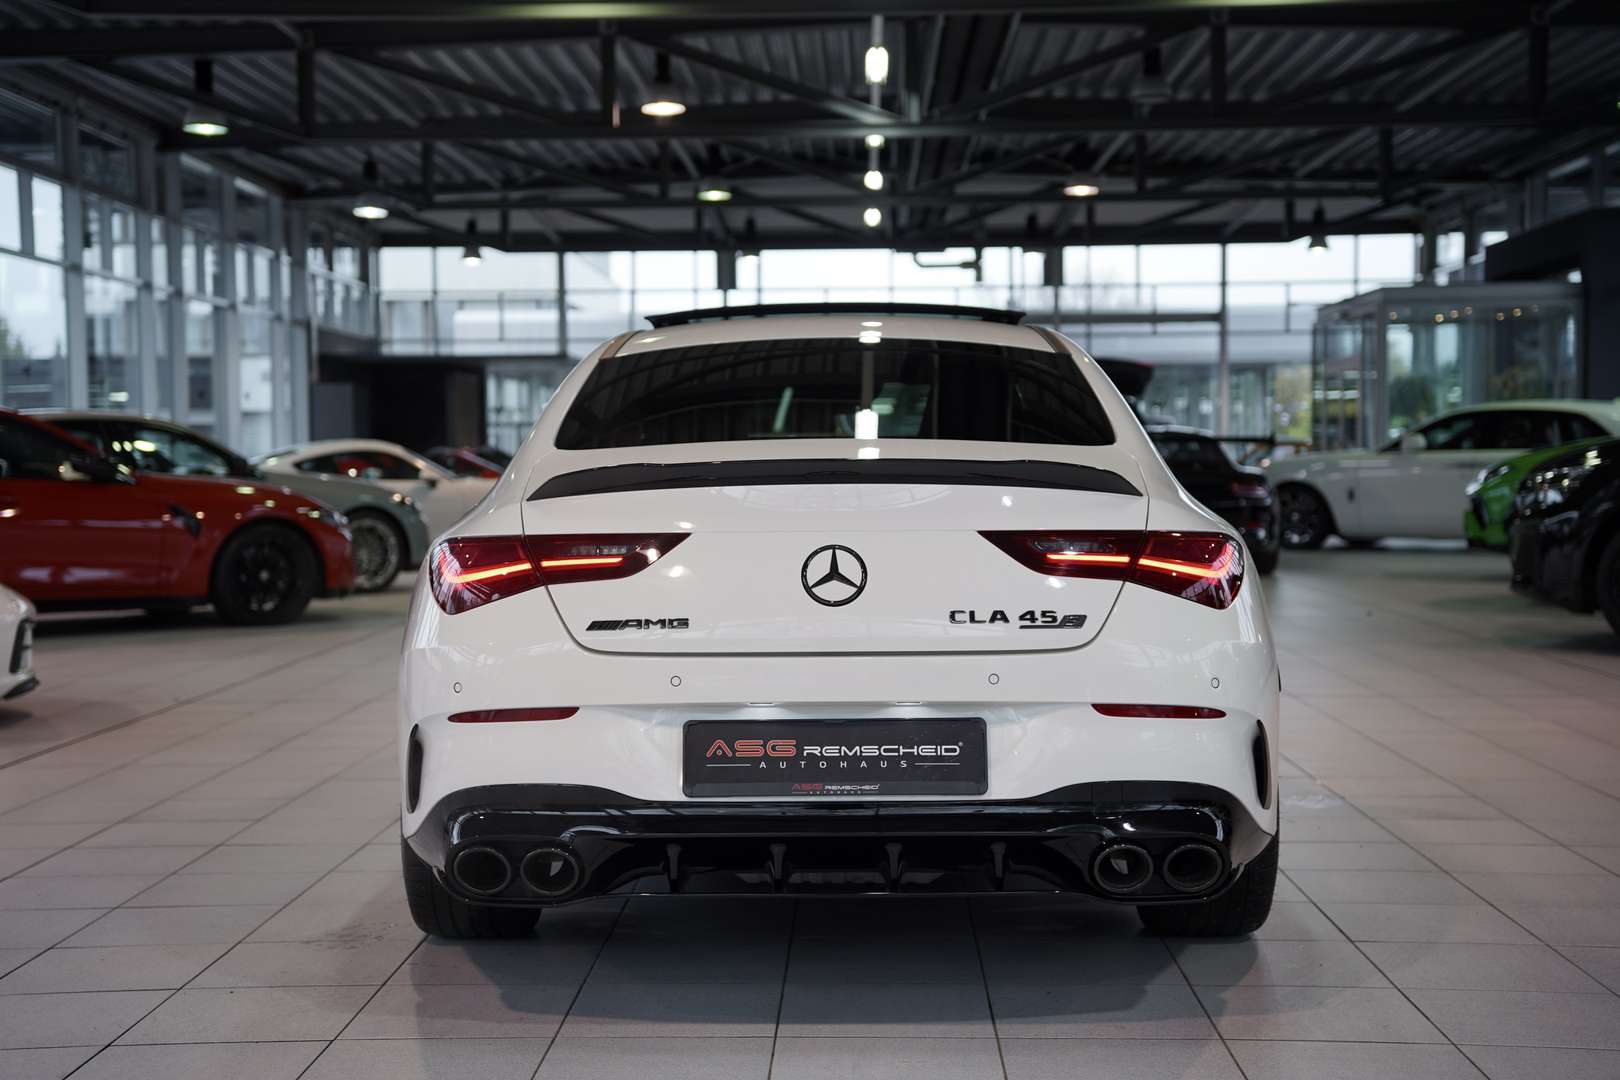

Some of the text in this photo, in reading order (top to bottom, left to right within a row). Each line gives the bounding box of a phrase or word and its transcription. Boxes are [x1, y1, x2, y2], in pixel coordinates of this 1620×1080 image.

[949, 609, 1010, 624] CLA
[617, 617, 690, 632] AMG
[705, 739, 961, 758] ASG REMSCHEID
[759, 760, 908, 769] AUTOHAUS
